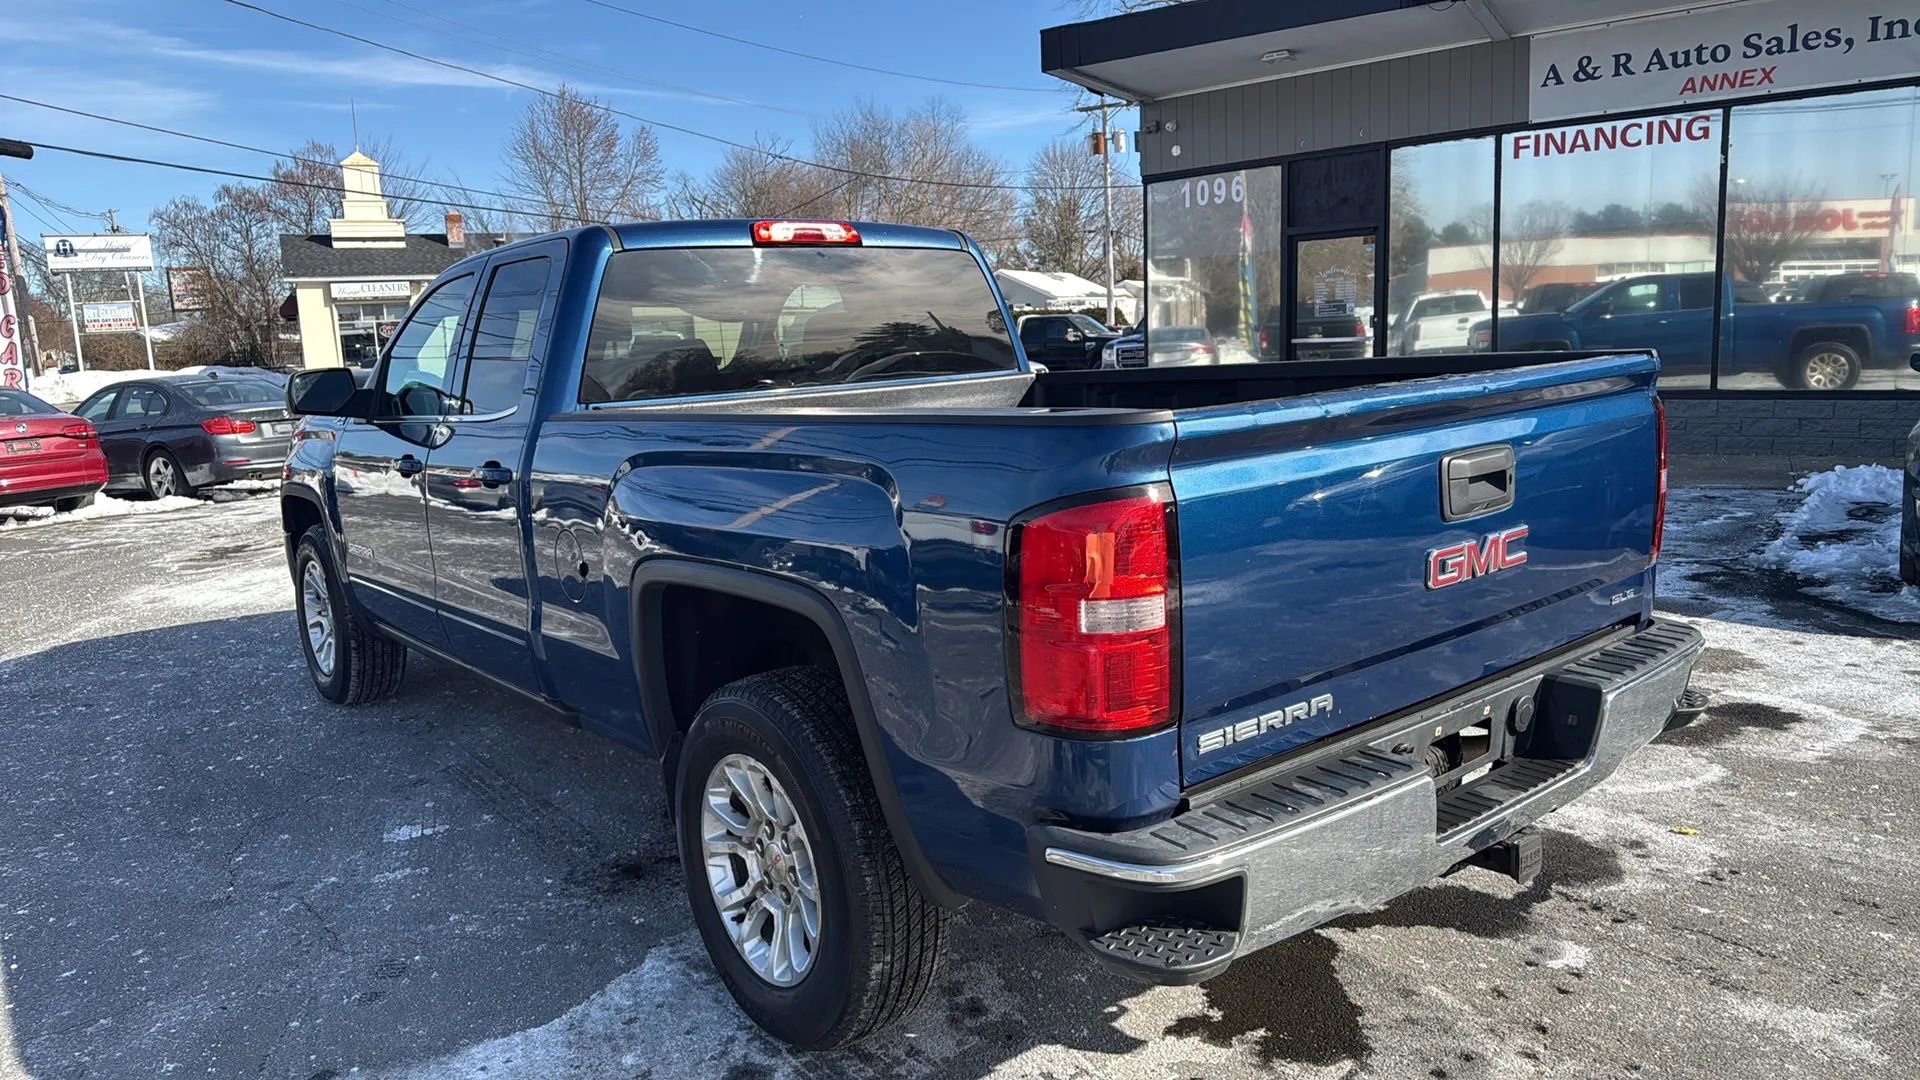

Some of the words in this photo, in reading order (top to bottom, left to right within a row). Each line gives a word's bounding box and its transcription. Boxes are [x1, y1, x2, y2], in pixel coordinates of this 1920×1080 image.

[1541, 64, 1563, 87] A
[1572, 56, 1602, 82] &
[1611, 52, 1635, 77] R
[1643, 42, 1731, 72] Auto
[1742, 23, 1855, 59] Sales,
[1679, 65, 1777, 95] ANNEX
[1512, 115, 1711, 160] FINANCING
[1180, 177, 1245, 209] 1096
[361, 284, 409, 292] CLEANERS
[1425, 524, 1529, 590] GMC
[1197, 693, 1333, 755] SIERRA
